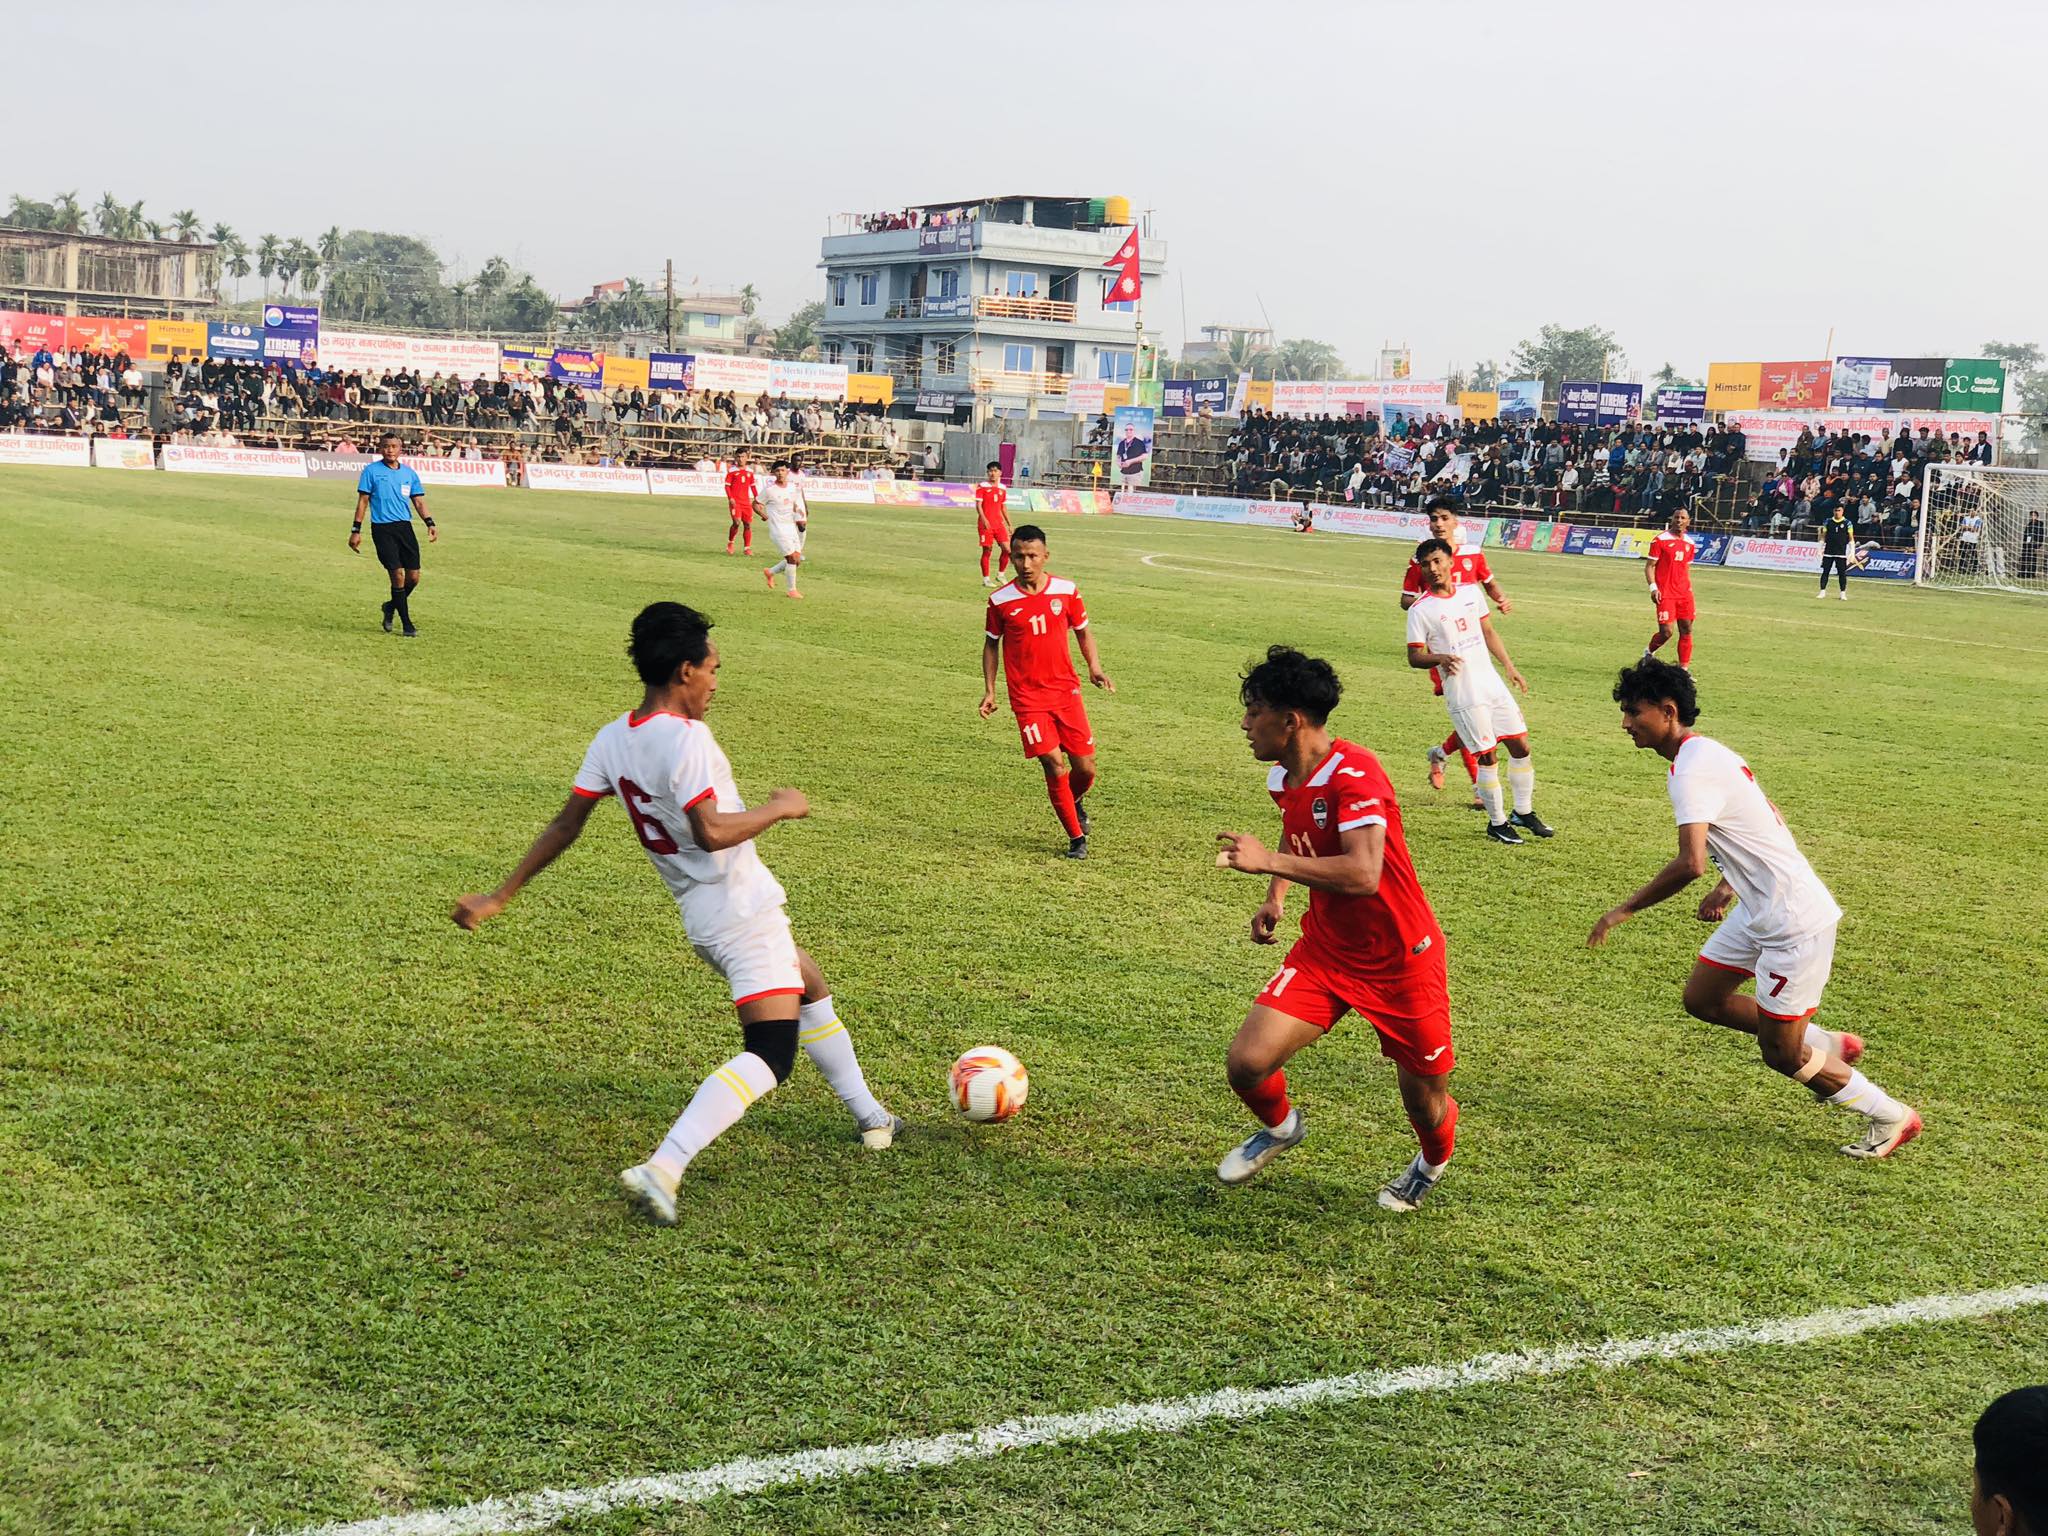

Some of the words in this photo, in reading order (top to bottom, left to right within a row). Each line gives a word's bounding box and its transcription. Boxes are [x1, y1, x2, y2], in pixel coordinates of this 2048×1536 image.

[159, 325, 195, 335] Himstar
[265, 338, 301, 351] XTREME
[359, 337, 406, 350] नगरपालिका
[651, 361, 683, 373] XTREME
[1714, 383, 1752, 392] Himstar
[1899, 375, 1942, 388] LEAPMOTOR
[1946, 375, 1969, 394] QC
[1600, 393, 1629, 407] XTREME
[1945, 418, 1992, 433] नगरपालिका
[184, 448, 228, 462] बिर्तामोड
[234, 450, 301, 465] नगरपालिका
[321, 458, 367, 473] LEAPMOTO
[402, 459, 496, 475] KINGSBURY
[579, 469, 643, 482] नगरपालिका
[1747, 539, 1782, 554] बिर्तामोड
[1869, 558, 1902, 570] XTREME
[1028, 614, 1047, 636] 11
[1454, 617, 1468, 632] 13
[1023, 722, 1042, 745] 11
[618, 775, 679, 855] 6
[1768, 971, 1789, 998] 7
